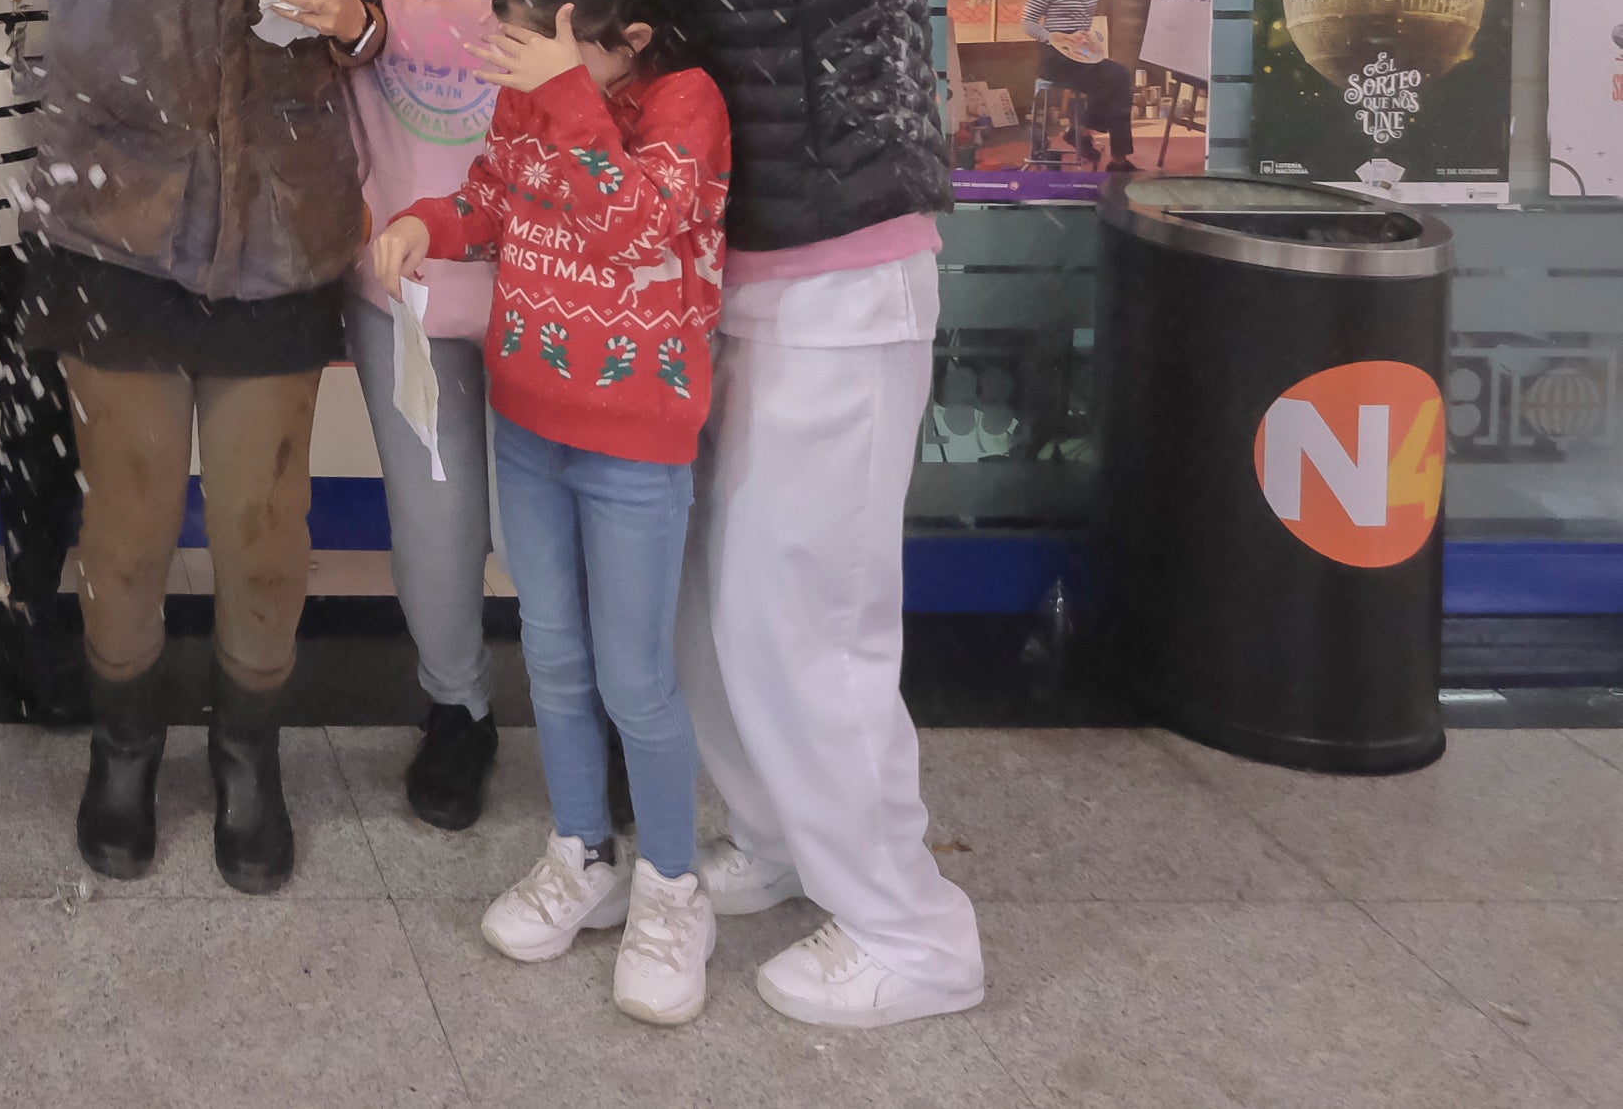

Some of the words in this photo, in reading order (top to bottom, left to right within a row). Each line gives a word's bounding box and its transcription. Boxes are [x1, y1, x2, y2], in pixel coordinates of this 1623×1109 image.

[1363, 52, 1397, 77] EL
[416, 80, 462, 99] SPAIN
[1344, 69, 1422, 105] SORTEO
[1363, 97, 1389, 111] QUE
[1392, 90, 1420, 113] NOS
[1355, 110, 1405, 143] UNE
[508, 215, 586, 253] MERRY
[1263, 397, 1444, 527] N4
